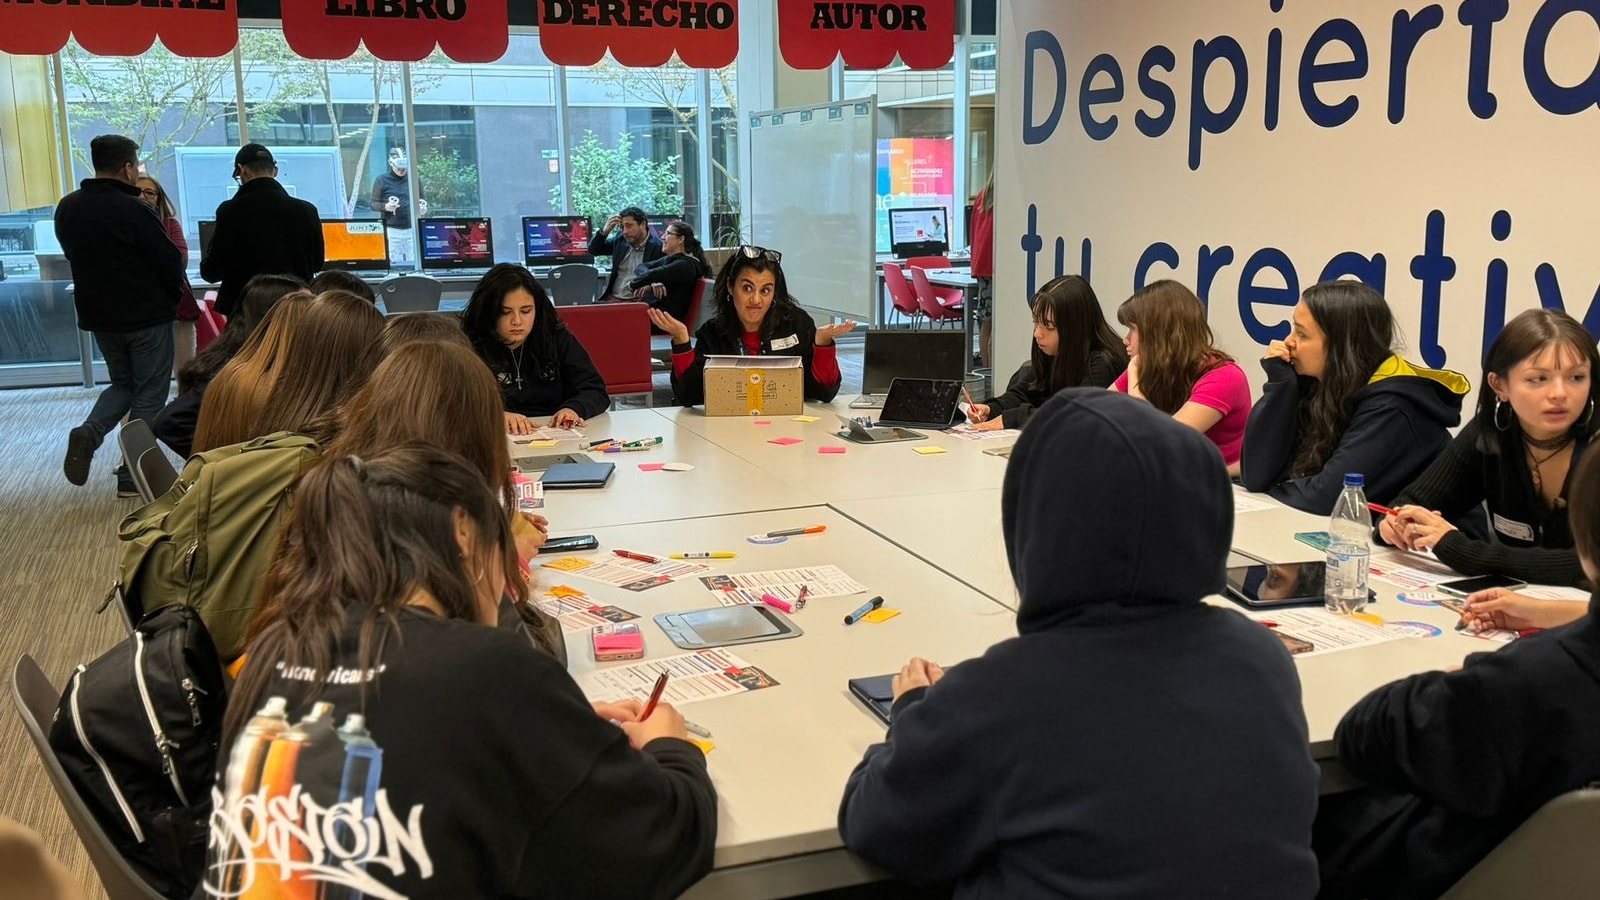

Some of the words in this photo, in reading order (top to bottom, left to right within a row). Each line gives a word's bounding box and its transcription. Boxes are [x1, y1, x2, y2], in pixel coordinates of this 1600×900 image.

[325, 0, 467, 21] LIBRO
[543, 0, 735, 30] DERECHO
[810, 3, 927, 31] AUTOR
